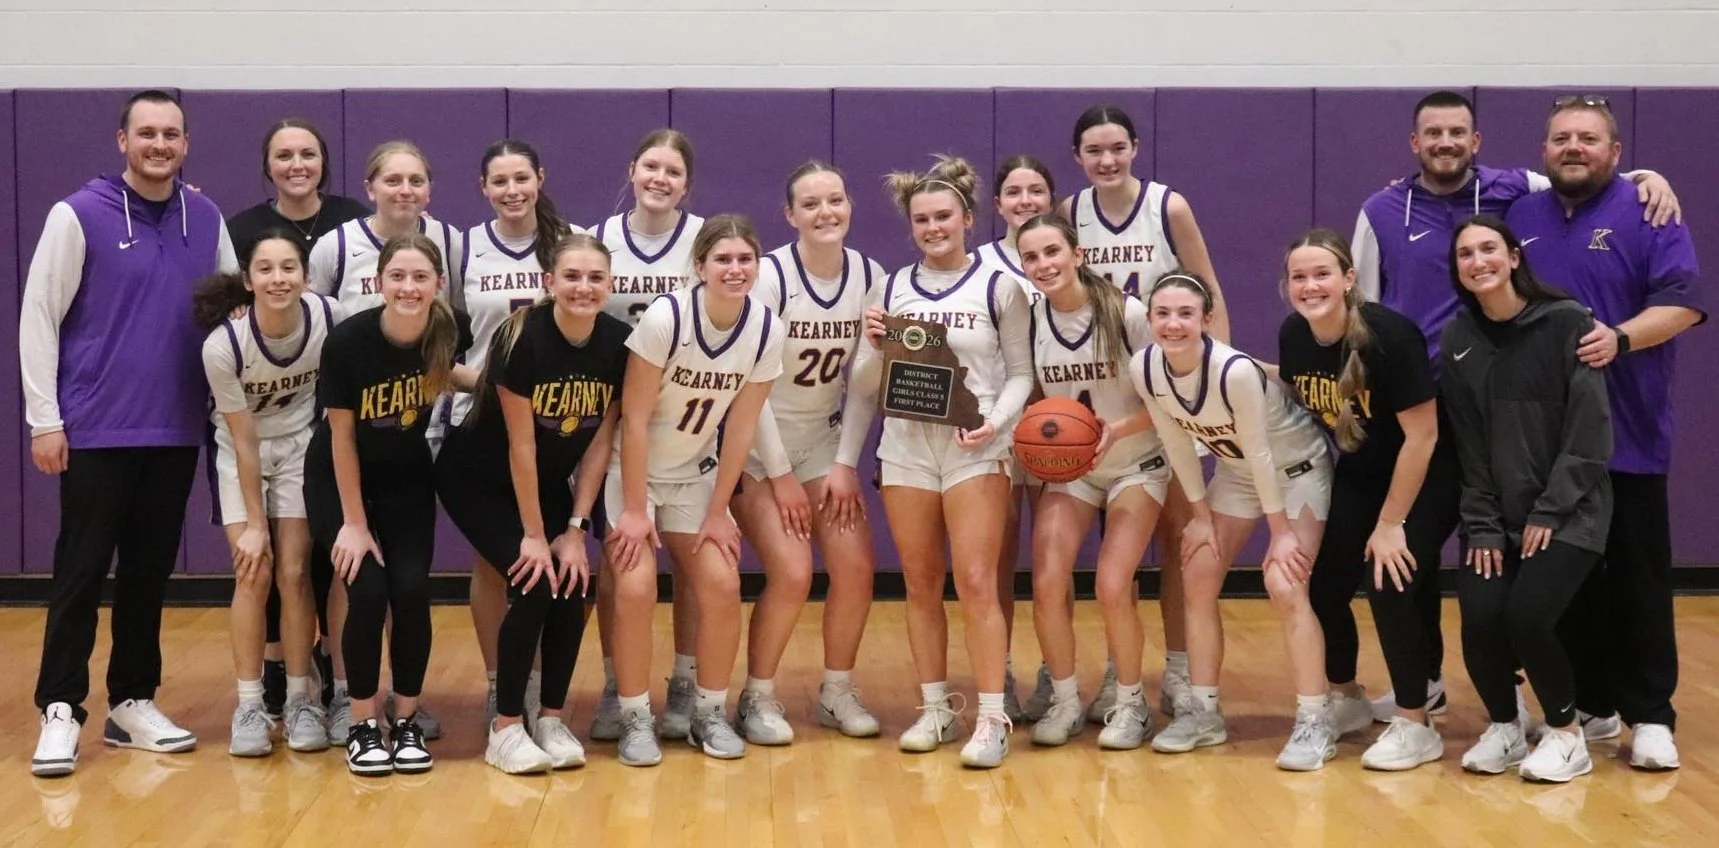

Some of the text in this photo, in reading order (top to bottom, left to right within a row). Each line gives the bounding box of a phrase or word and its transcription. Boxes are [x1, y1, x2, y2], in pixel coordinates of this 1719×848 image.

[1588, 229, 1613, 250] K
[1081, 245, 1154, 265] KEARNEY
[787, 321, 860, 339] KEARNEY
[888, 329, 903, 341] 20
[926, 334, 941, 346] 26
[793, 348, 845, 387] 20
[904, 370, 938, 380] DISTRICT
[1043, 362, 1117, 383] KEARNEY
[671, 365, 744, 391] KEARNEY
[896, 378, 943, 391] BASKETBALL
[532, 381, 614, 417] KEARNEY
[892, 388, 915, 397] GIRLS
[916, 391, 939, 400] CLASS
[894, 397, 940, 410] FIRST PLACE
[676, 397, 715, 435] 11
[1024, 452, 1080, 468] SPALDING
